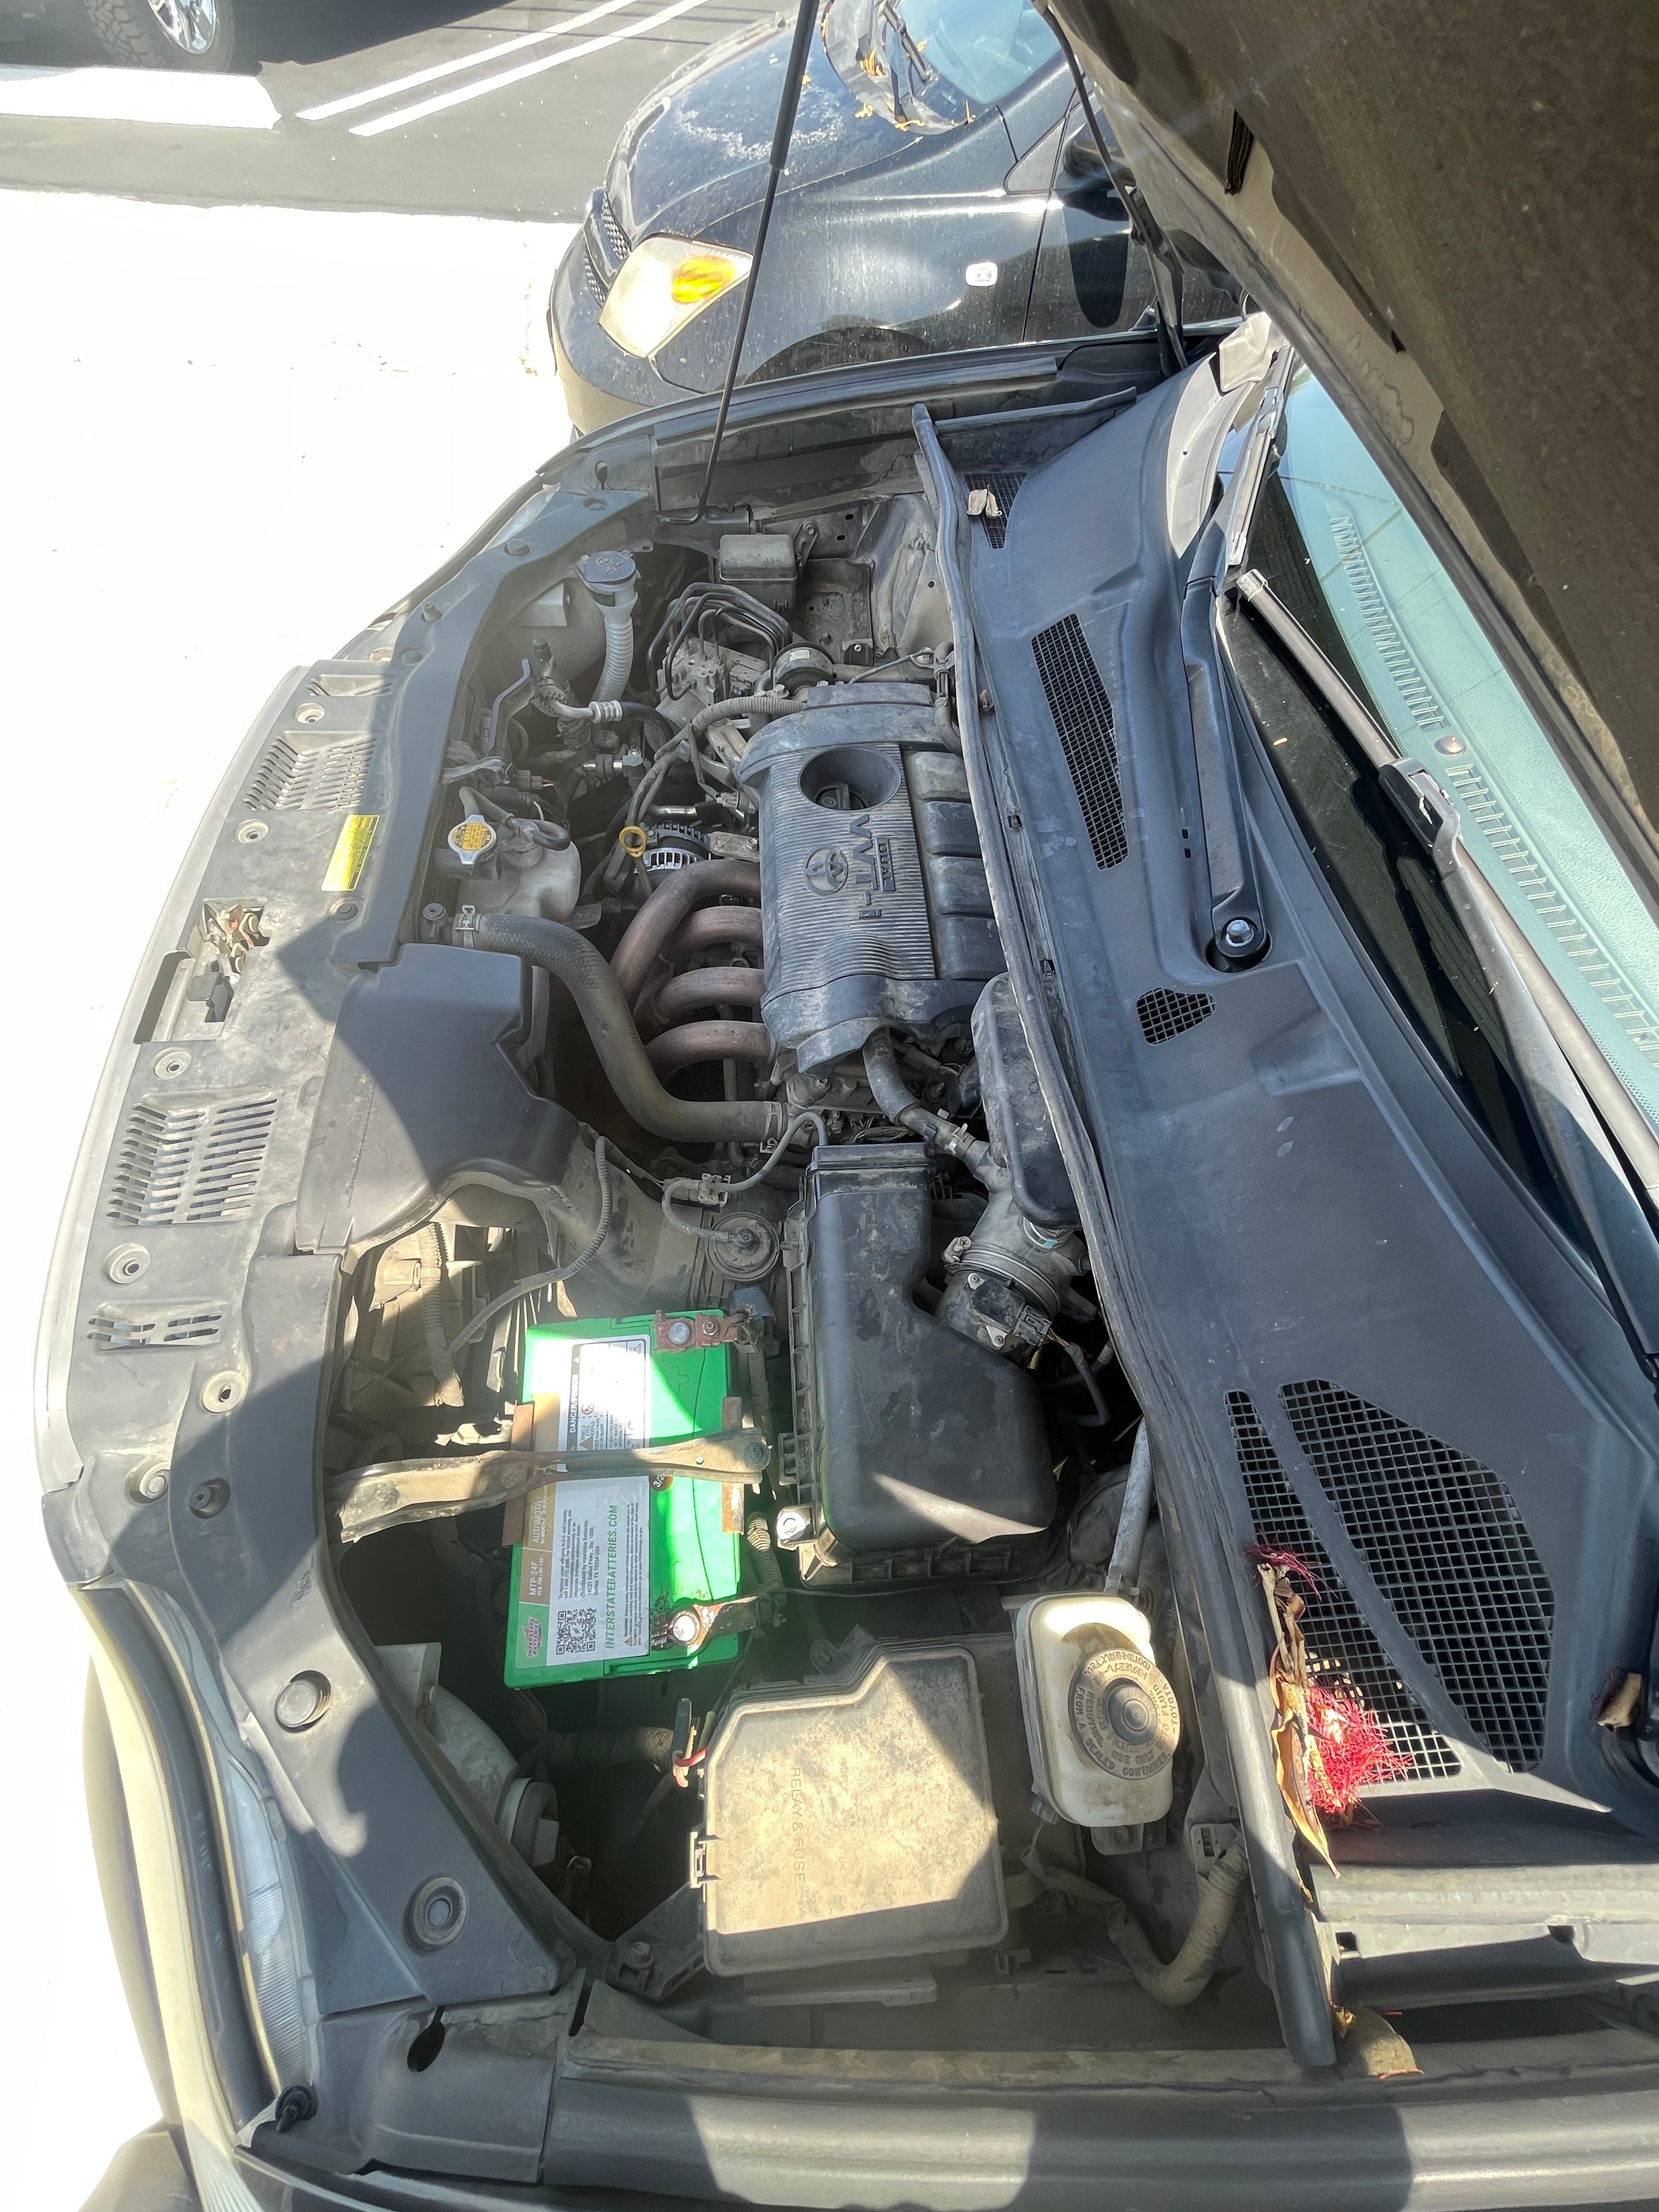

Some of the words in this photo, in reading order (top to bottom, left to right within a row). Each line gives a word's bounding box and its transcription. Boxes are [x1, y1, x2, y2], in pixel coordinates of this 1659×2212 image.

[878, 843, 892, 887] DUAL
[533, 1494, 542, 1543] AUTOMOTIVE
[529, 1561, 538, 1595] MTP-24F
[606, 1505, 618, 1649] INTERSTATEBATTERIES.COM
[1153, 1684, 1169, 1716] FLUID
[1076, 1686, 1085, 1715] FROM
[1085, 1738, 1115, 1770] SEALED
[790, 1768, 803, 1817] RELAY
[792, 1822, 803, 1832] &
[793, 1838, 805, 1883] FUSE
